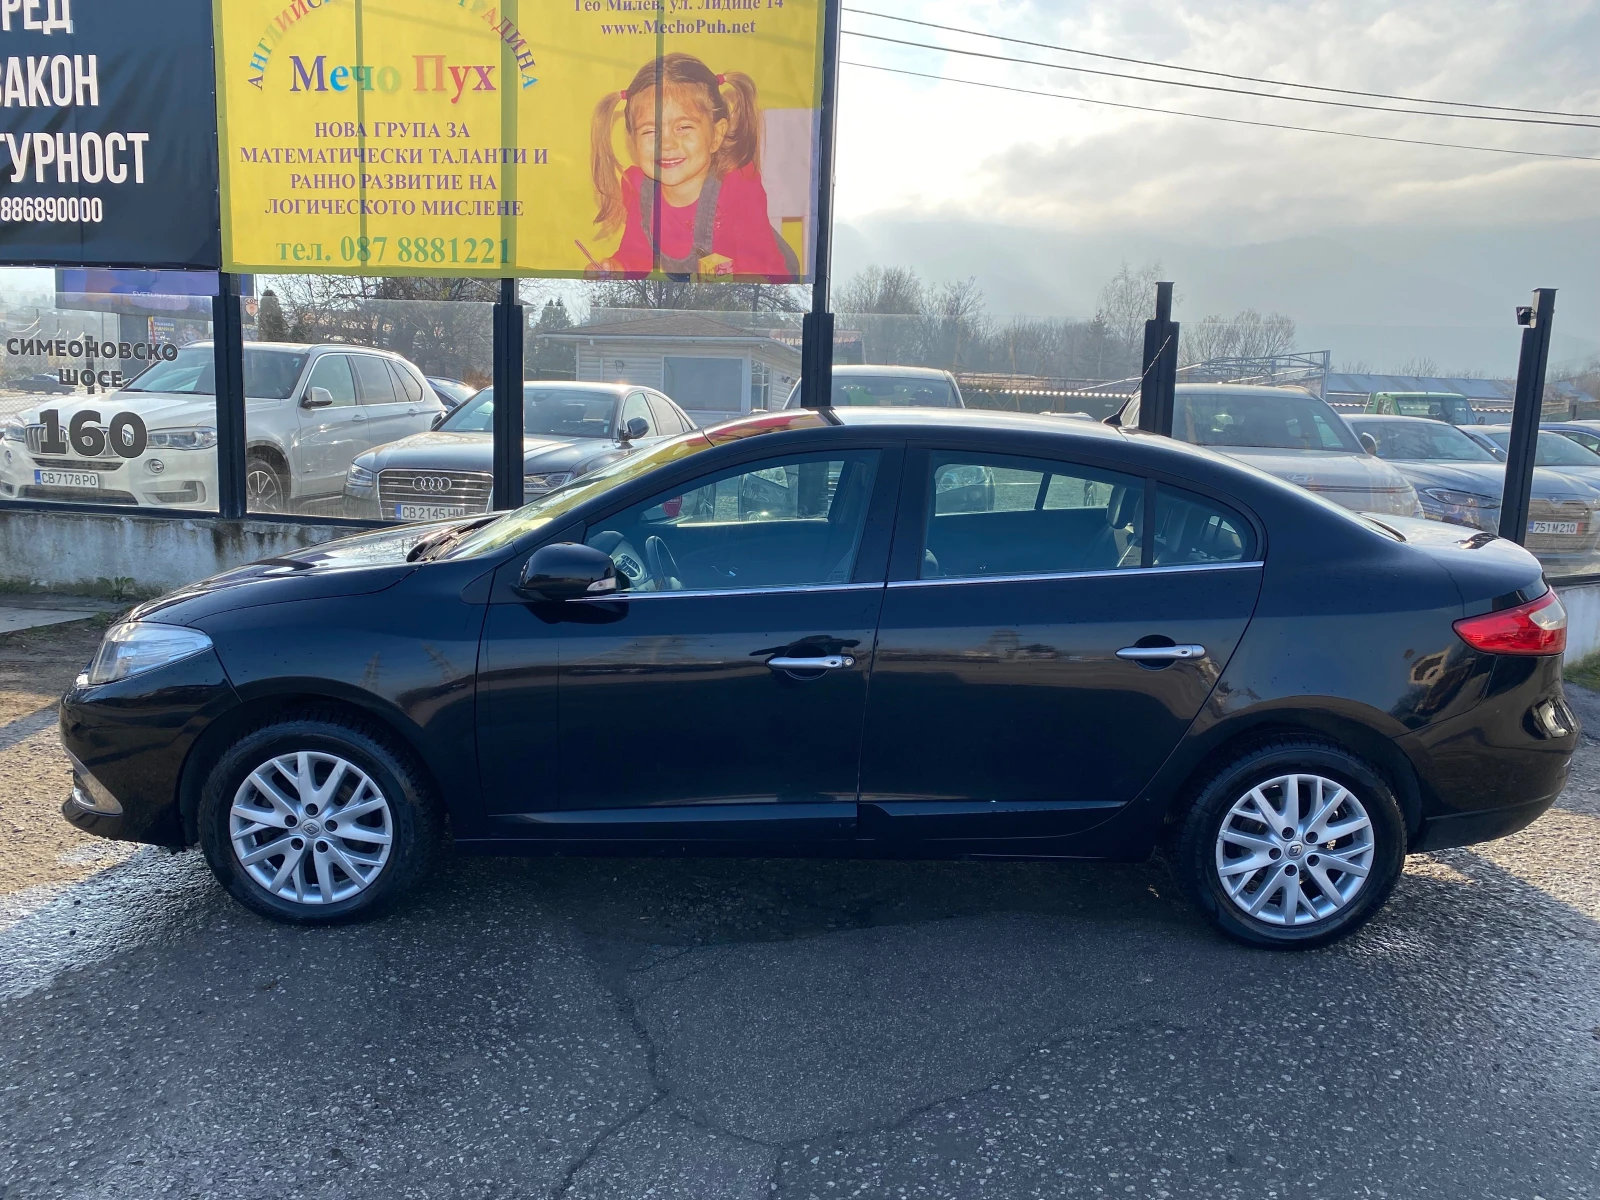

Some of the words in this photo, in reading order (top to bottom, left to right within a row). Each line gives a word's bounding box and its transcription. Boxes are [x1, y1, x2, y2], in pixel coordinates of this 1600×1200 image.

[601, 19, 756, 35] www.MechoPuh.net
[289, 55, 399, 92] Мечо
[412, 54, 496, 104] Пух
[315, 122, 367, 138] НОВА
[374, 122, 441, 138] ГРУПА
[446, 122, 470, 138] ЗА
[239, 147, 423, 164] МАТЕМАТИЧЕСКИ
[428, 148, 527, 165] ТАЛАНТИ
[533, 148, 549, 165] И
[290, 173, 355, 190] РАННО
[361, 174, 463, 190] РАЗВИТИЕ
[469, 174, 497, 190] НА
[264, 198, 416, 216] ЛОГИЧЕСКОТО
[421, 199, 524, 217] МИСЛЕНЕ
[276, 241, 331, 262] тел.
[340, 236, 388, 262] 087
[397, 237, 511, 264] 8881221
[6, 337, 179, 361] СИМЕОНОВСКО
[58, 367, 124, 388] ШОСЕ
[39, 409, 148, 459] 160
